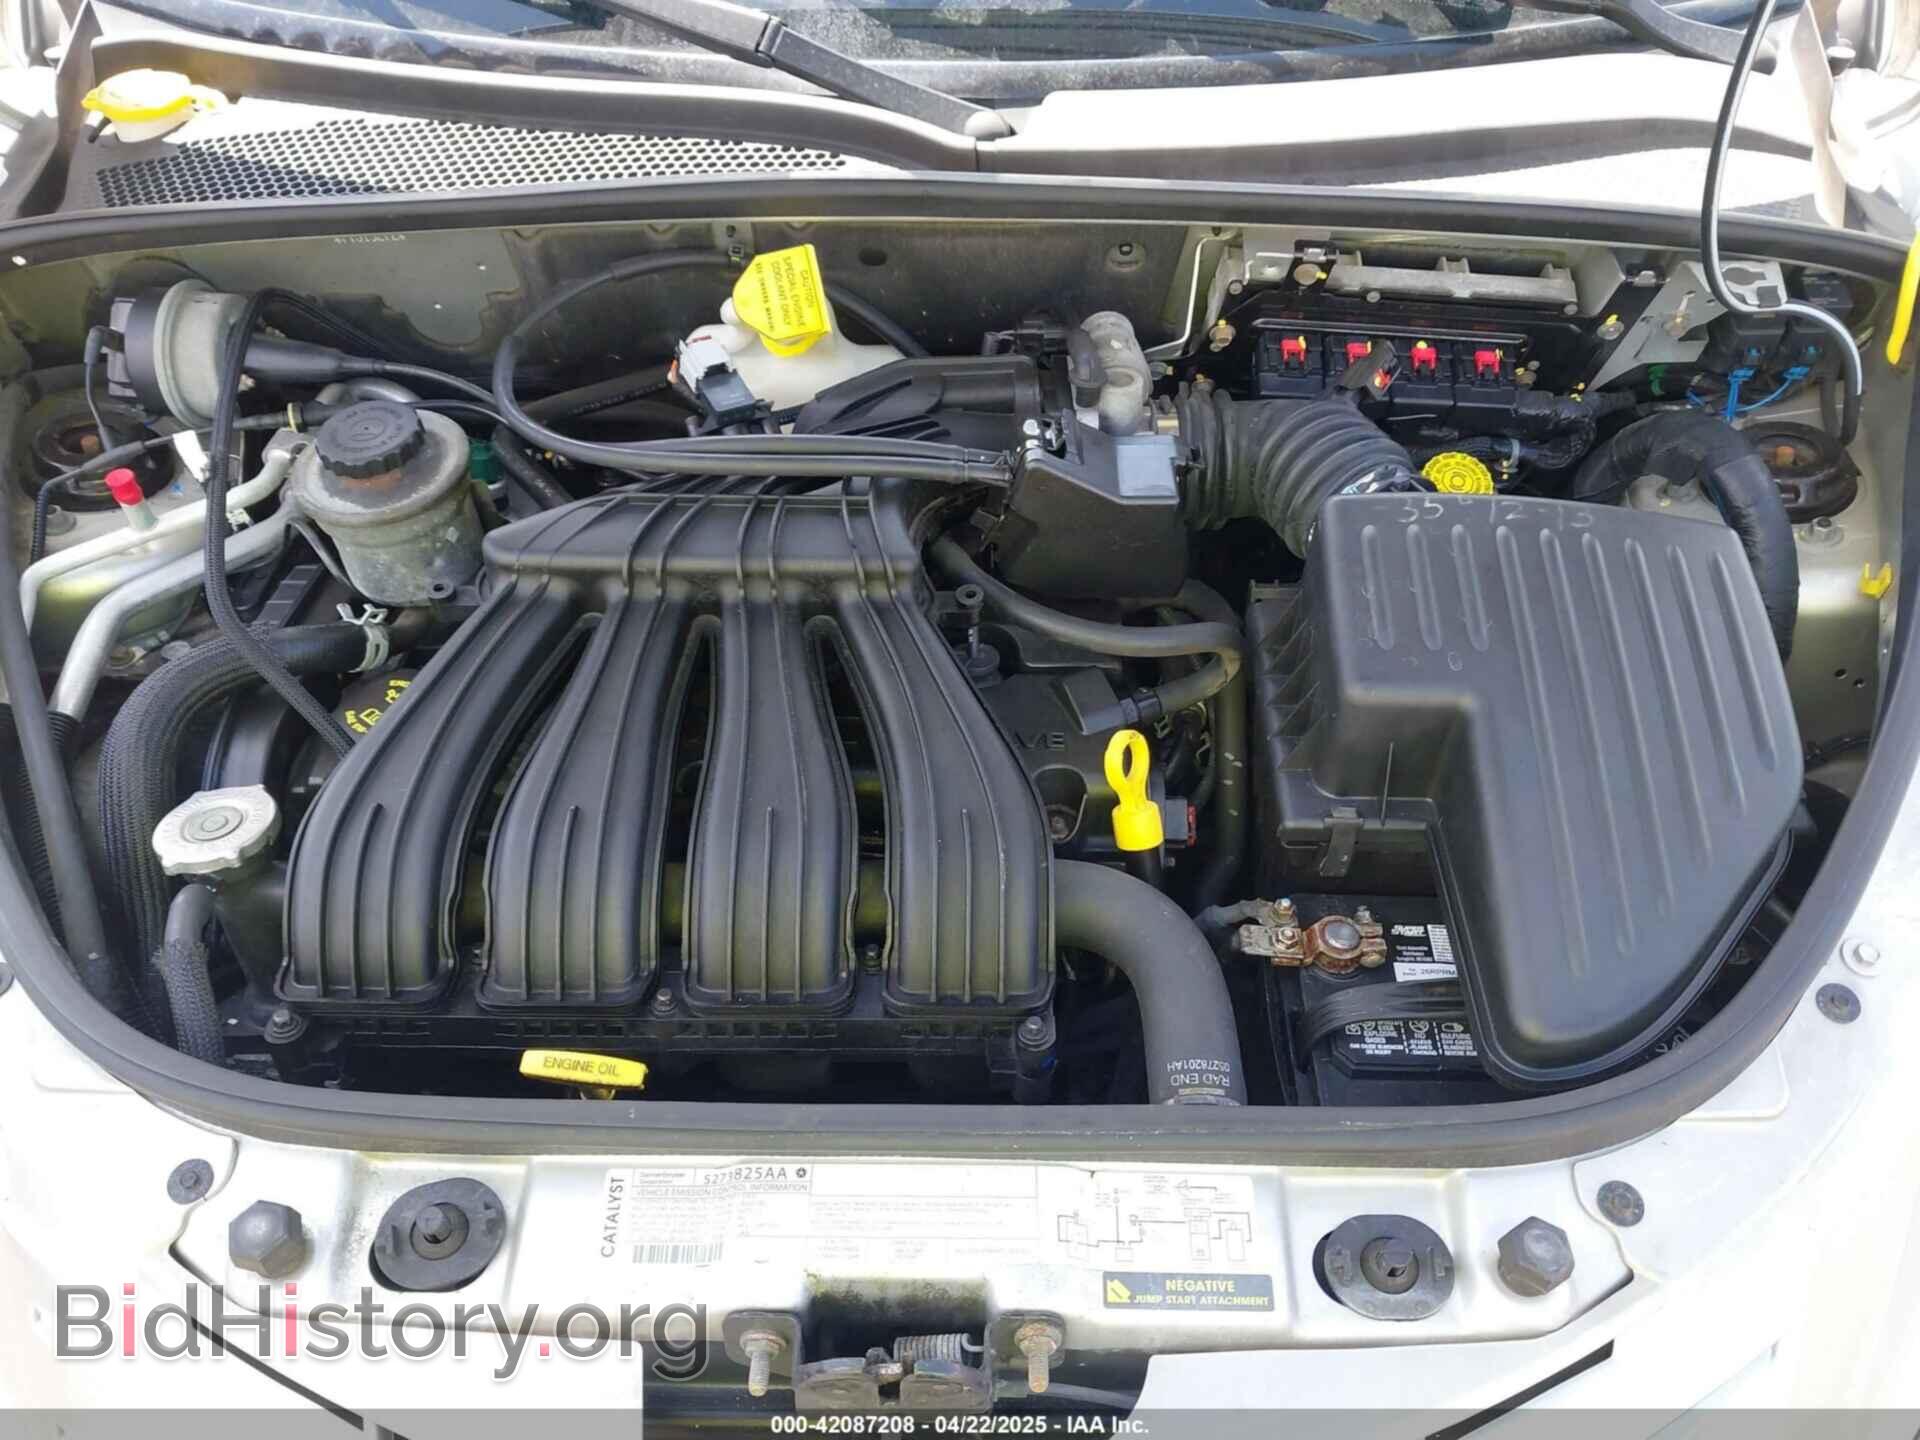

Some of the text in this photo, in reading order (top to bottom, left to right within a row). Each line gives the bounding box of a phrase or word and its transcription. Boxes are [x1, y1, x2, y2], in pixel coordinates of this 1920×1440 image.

[543, 1056, 620, 1078] ENGINE OIL
[1170, 1072, 1231, 1087] RAD END
[636, 1188, 668, 1198] VEHICLE
[671, 1188, 711, 1198] EMISSION
[750, 1182, 809, 1192] INFORMATION
[600, 1176, 625, 1258] CATALYST
[1166, 1279, 1236, 1293] NEGATIVE
[1135, 1294, 1269, 1306] JUMP START ATTACHMENT
